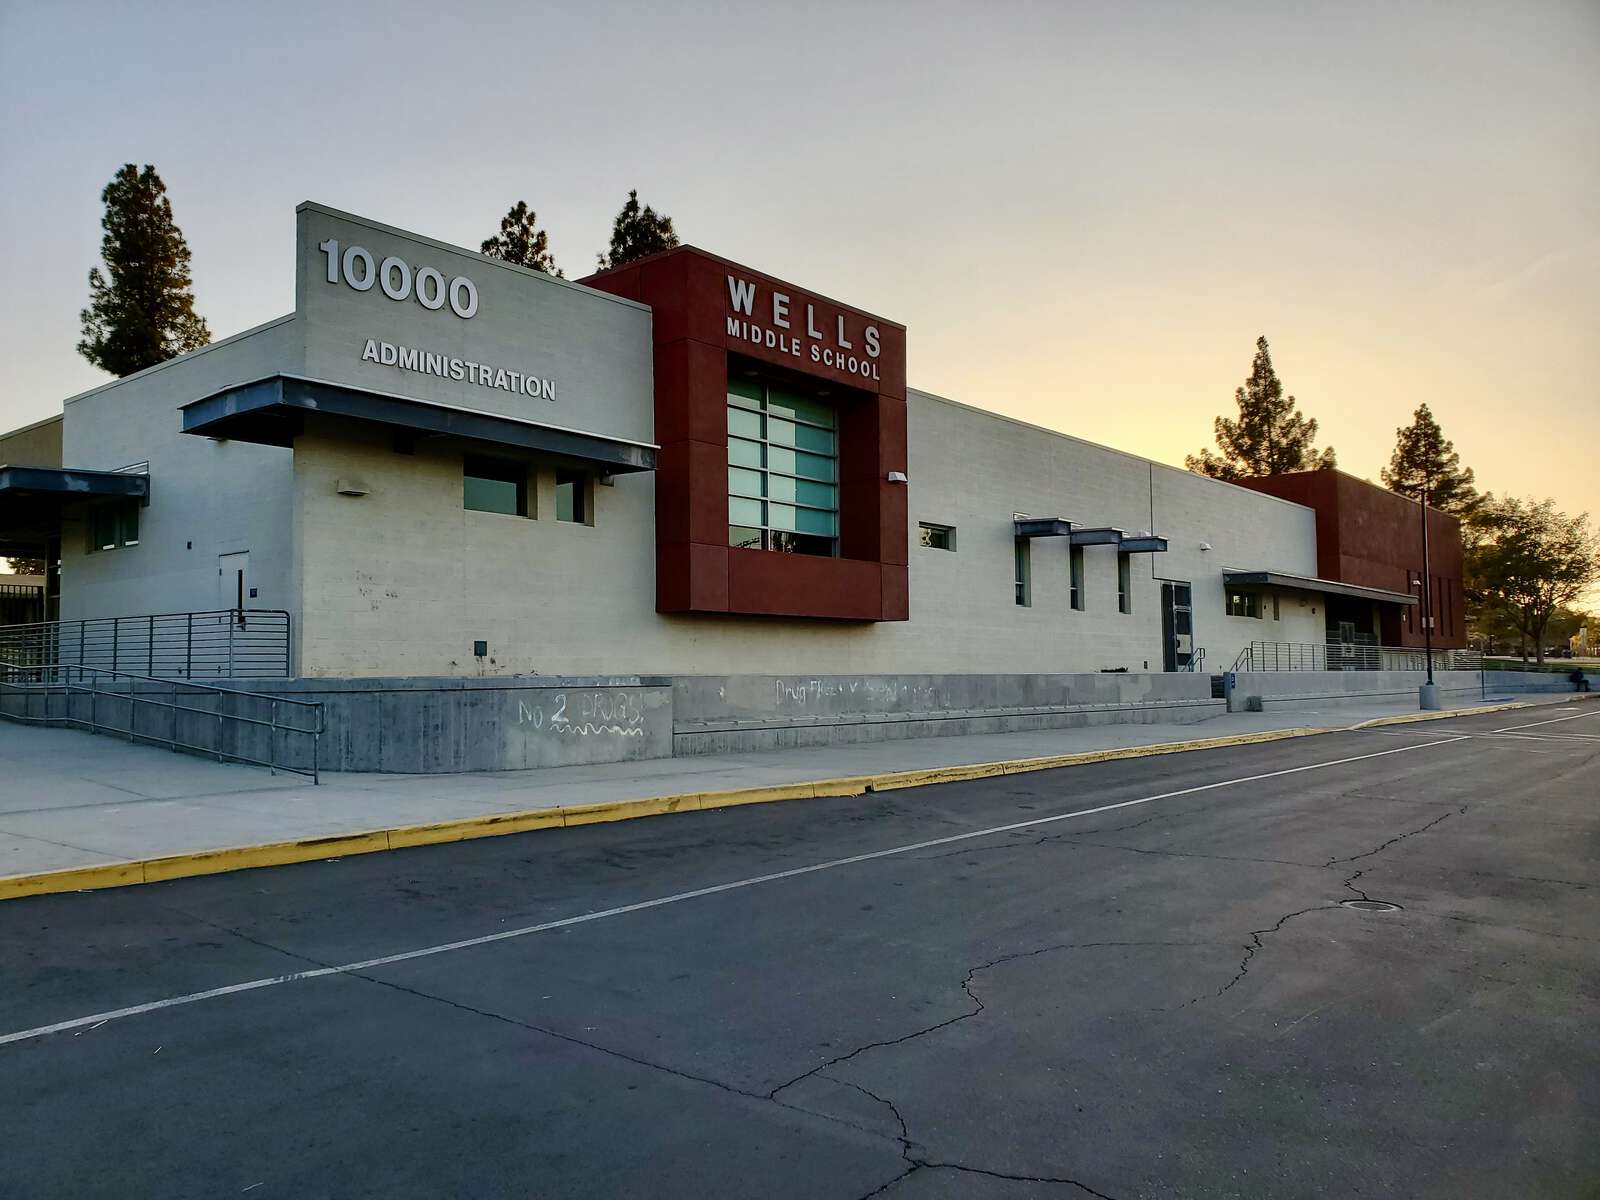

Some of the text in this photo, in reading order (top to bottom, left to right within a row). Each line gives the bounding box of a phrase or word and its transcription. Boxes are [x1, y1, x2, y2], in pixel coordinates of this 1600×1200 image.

[320, 238, 479, 319] 10000
[727, 274, 881, 358] WELLS
[727, 316, 881, 381] MIDDLE SCHOOL
[361, 338, 556, 401] ADMINISTRATION
[551, 693, 570, 723] 2
